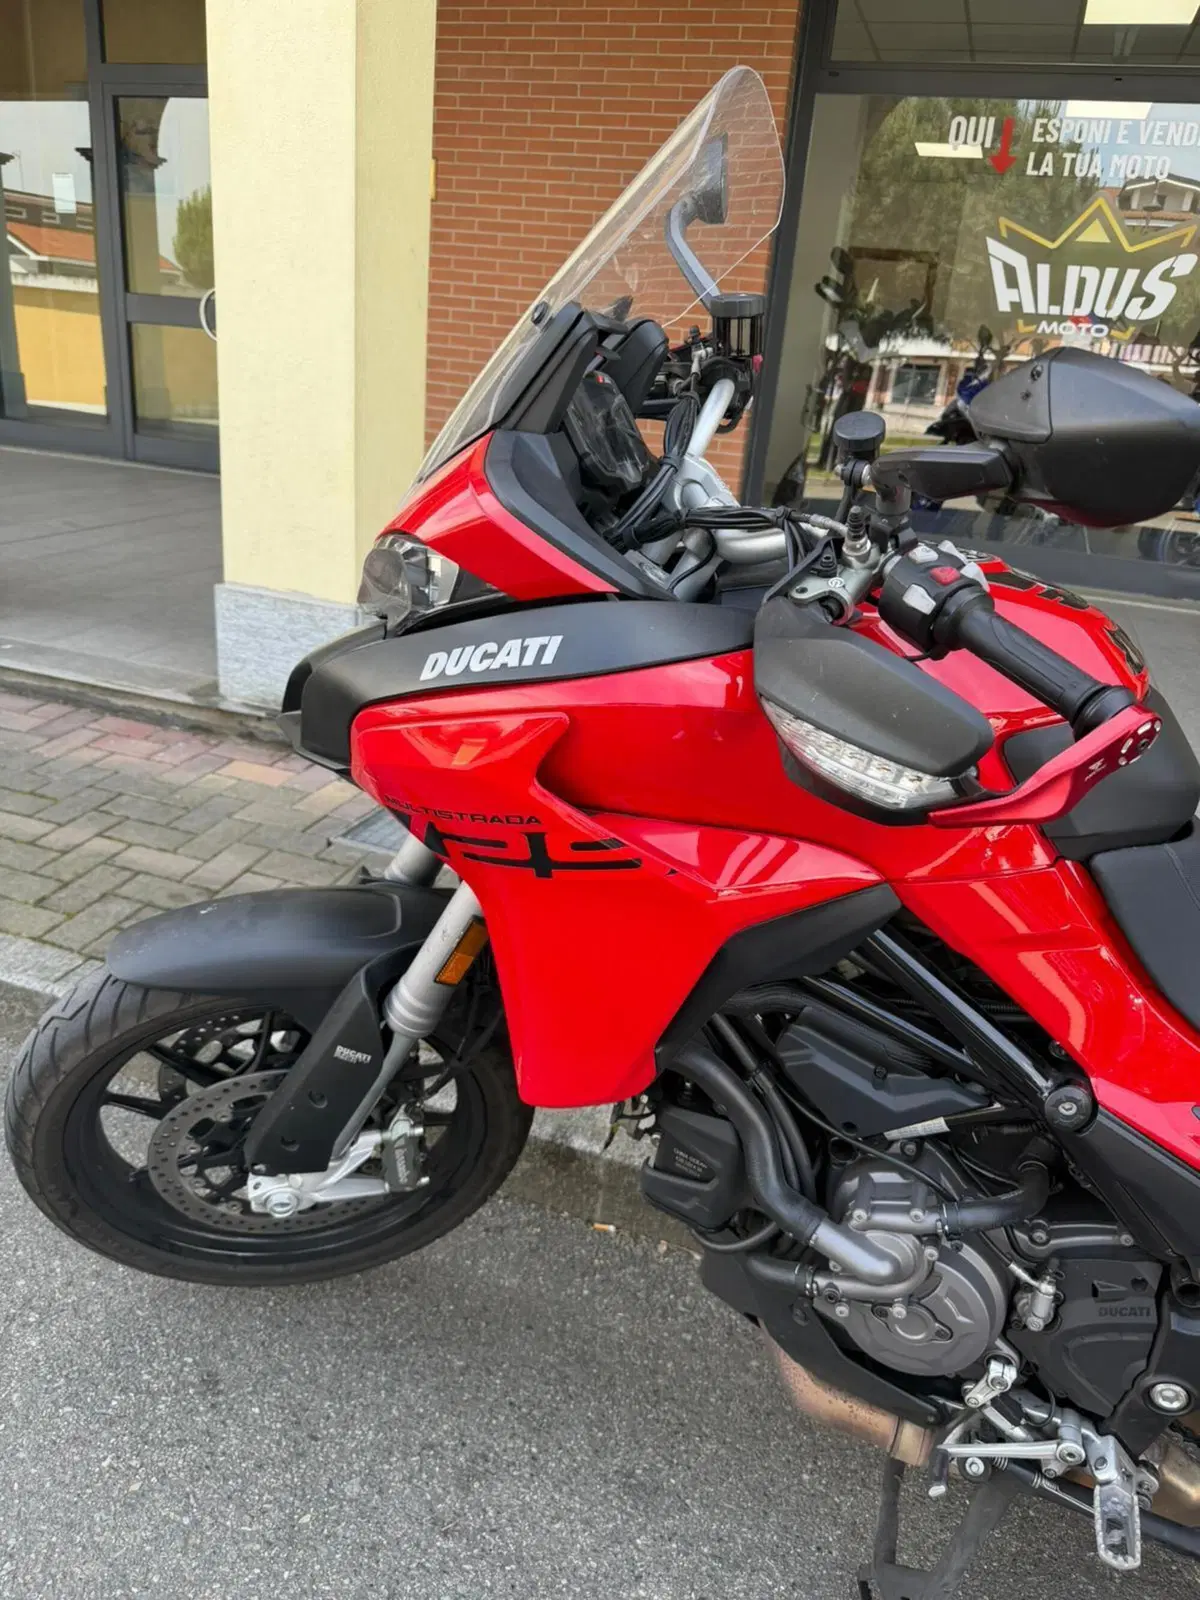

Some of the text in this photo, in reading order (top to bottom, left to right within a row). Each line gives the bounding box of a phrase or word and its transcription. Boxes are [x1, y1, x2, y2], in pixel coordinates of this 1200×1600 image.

[948, 115, 996, 151] QUI
[1031, 117, 1200, 147] ESPONI E VEND
[1026, 152, 1172, 180] LA TUA MOTO
[985, 236, 1199, 321] ALDUS
[1036, 320, 1109, 338] MOTO
[419, 634, 564, 681] DUCATI
[383, 794, 542, 826] MULTISTRADA
[335, 1044, 372, 1063] DUCATI
[1098, 1305, 1152, 1318] DUCATI
